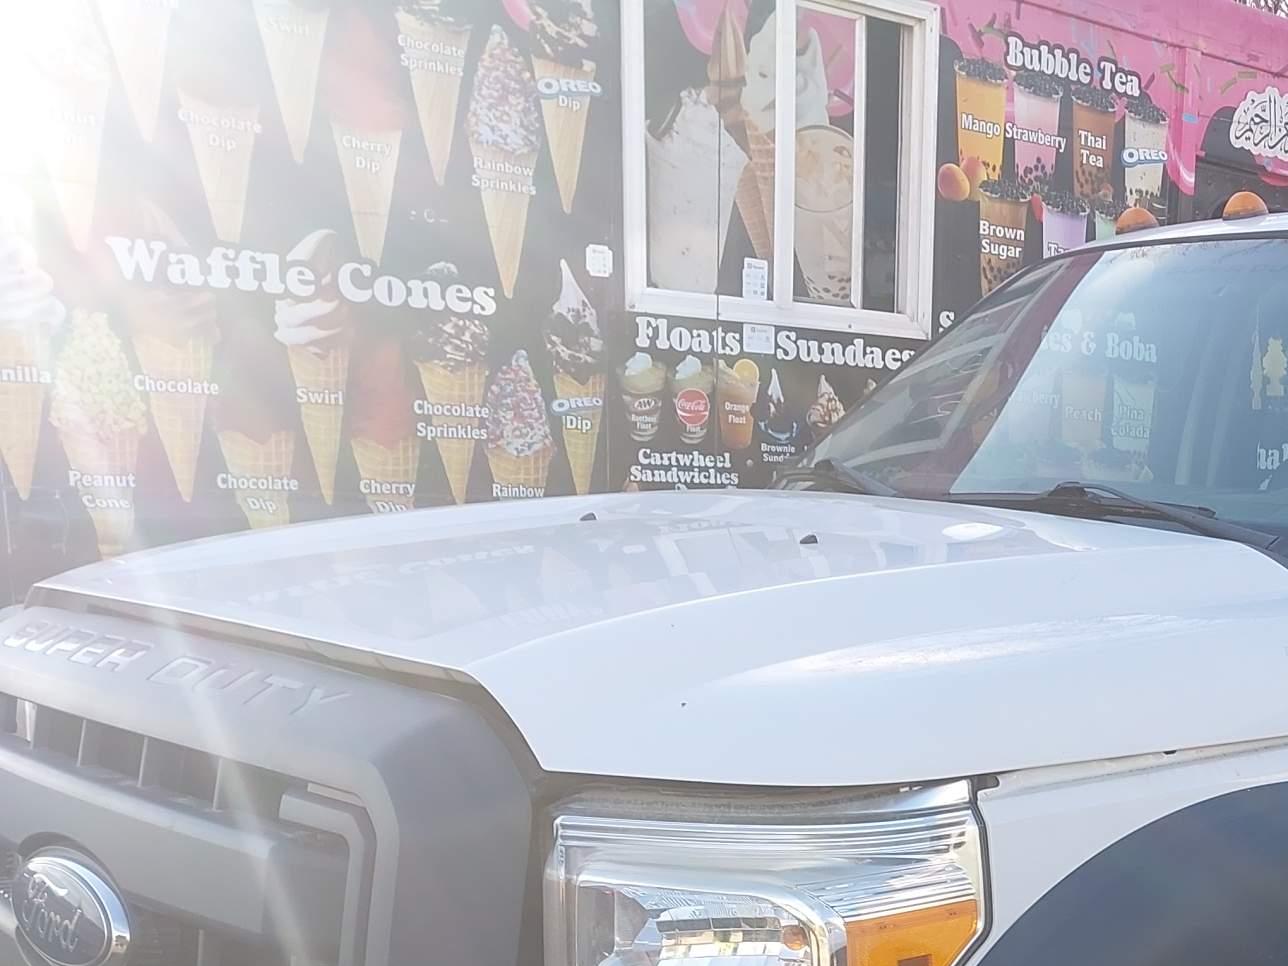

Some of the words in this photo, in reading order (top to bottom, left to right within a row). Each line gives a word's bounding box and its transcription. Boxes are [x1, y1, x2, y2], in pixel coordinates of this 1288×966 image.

[398, 34, 465, 58] Chocolate
[401, 54, 464, 77] Sprinkles
[1006, 35, 1091, 83] Bubble
[1100, 61, 1140, 98] Tea
[537, 78, 601, 97] OREO
[559, 96, 580, 111] Dip
[178, 107, 262, 134] Chocolate
[961, 113, 1000, 138] Mango
[208, 134, 236, 151] Dip
[342, 135, 391, 157] Cherry
[1005, 122, 1067, 152] Strawberry
[1078, 130, 1107, 150] Thai
[355, 156, 381, 174] Dip
[1080, 150, 1104, 168] Tea
[1122, 148, 1168, 163] OREO
[473, 157, 534, 178] Rainbow
[471, 174, 536, 196] Sprinkles
[979, 220, 1025, 241] Brown
[981, 239, 1022, 260] Sugar
[1048, 242, 1069, 255] Ta
[105, 236, 317, 297] Waffle
[337, 262, 497, 316] Cones
[635, 316, 740, 355] Floats
[1080, 330, 1096, 356] &
[1105, 332, 1157, 363] Boba
[1, 367, 51, 383] nilla
[134, 374, 219, 396] Chocolate
[296, 388, 344, 405] Swirl
[552, 398, 603, 412] OREO
[413, 400, 490, 420] Chocolate
[725, 401, 750, 414] Orange
[567, 416, 592, 432] Dip
[728, 414, 747, 424] Float
[416, 422, 488, 441] Sprinkles
[761, 443, 796, 453] Brownie
[762, 453, 790, 462] Sund
[638, 448, 731, 468] Cartwheel
[69, 470, 136, 488] Peanut
[216, 473, 299, 492] Chocolate
[630, 465, 739, 485] Sandwiches
[359, 479, 415, 499] Cherry
[492, 483, 545, 499] Rainbow
[82, 495, 131, 510] Cone
[247, 498, 277, 513] Dip
[1, 618, 154, 672] SUPER
[146, 654, 352, 716] DUTY
